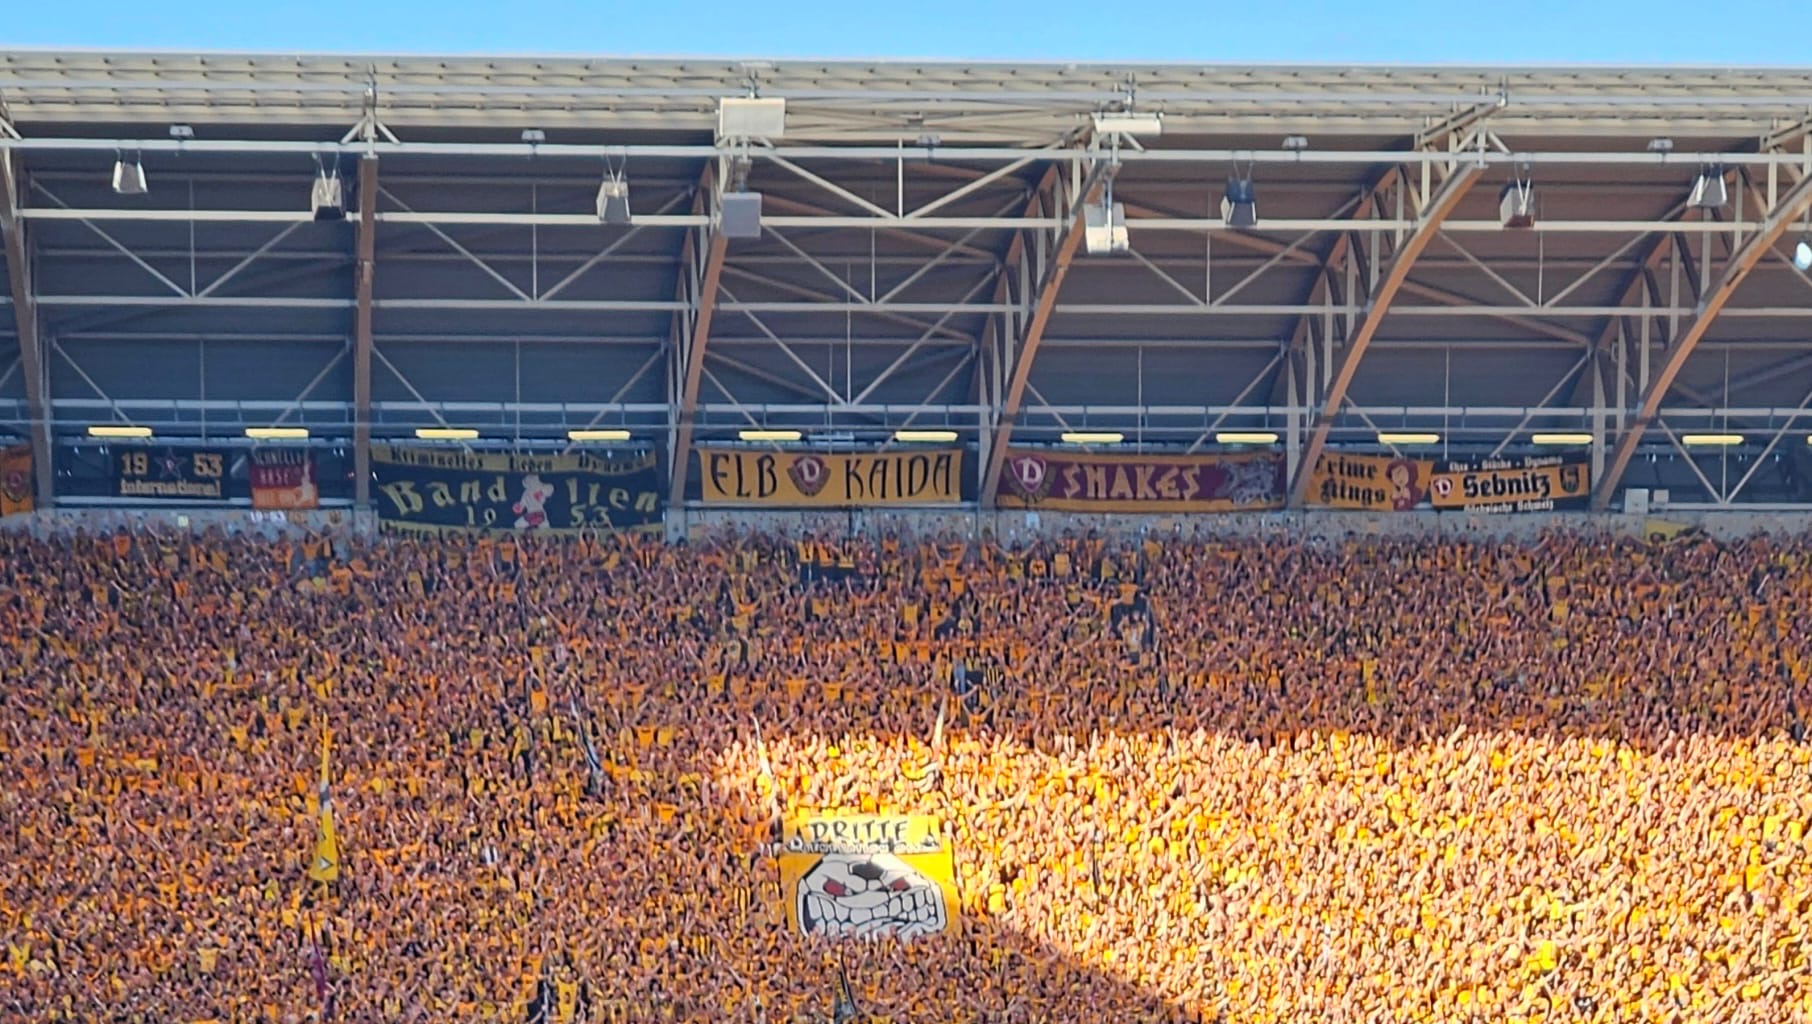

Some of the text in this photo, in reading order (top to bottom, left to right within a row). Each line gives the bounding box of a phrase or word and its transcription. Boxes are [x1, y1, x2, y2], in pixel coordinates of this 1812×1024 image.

[121, 453, 222, 477] 19 53
[710, 453, 777, 498] ELB
[845, 453, 953, 499] KAIDA
[1062, 462, 1200, 500] SNAKES
[379, 476, 507, 515] Band
[1463, 471, 1550, 499] Sebnitz
